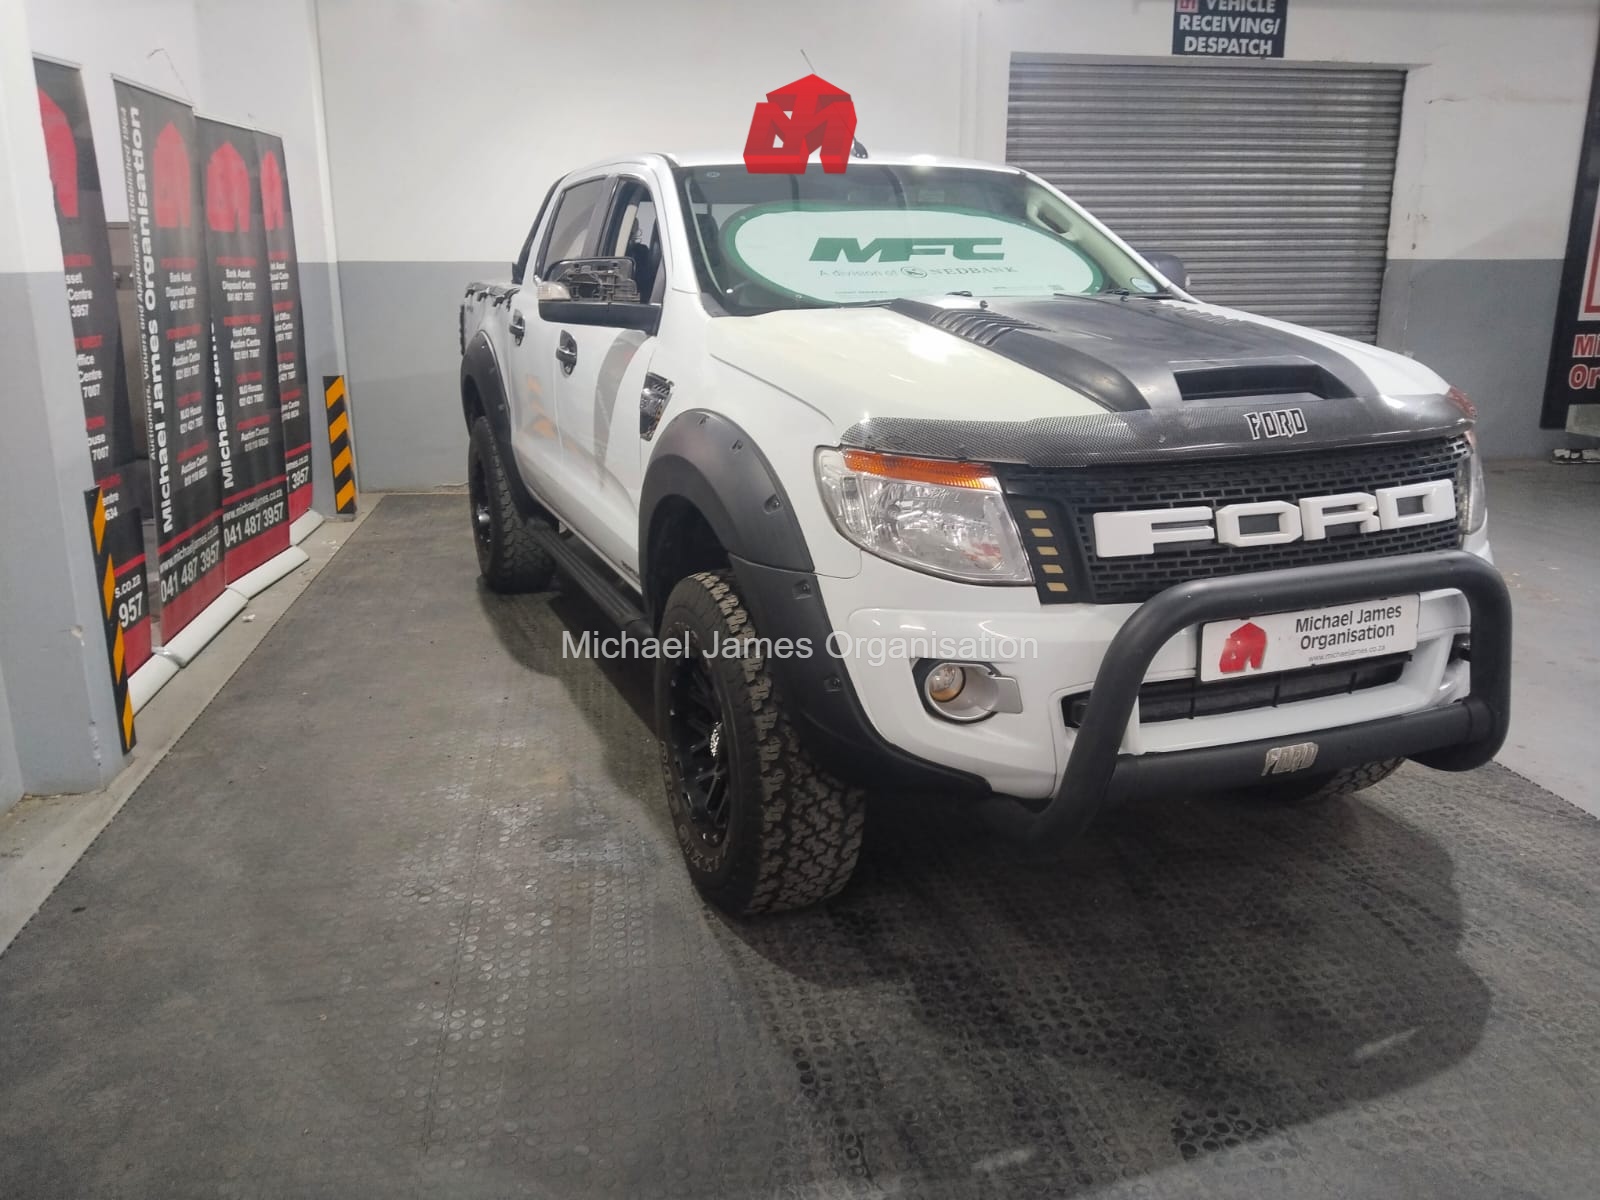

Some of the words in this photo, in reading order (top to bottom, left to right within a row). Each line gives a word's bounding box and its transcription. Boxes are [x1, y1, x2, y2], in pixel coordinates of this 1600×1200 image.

[1206, 0, 1276, 13] VEHICLE
[1179, 14, 1280, 35] RECEIVING/
[1184, 36, 1273, 55] DESPATCH
[130, 107, 156, 311] Organisation
[808, 237, 1005, 263] MFC
[70, 304, 89, 318] 3957
[77, 354, 95, 366] ffice
[148, 319, 164, 414] James
[1243, 407, 1308, 440] FORD
[88, 433, 106, 447] ouse
[215, 394, 234, 489] Michael
[157, 422, 173, 533] Michael
[102, 492, 119, 507] entre
[223, 488, 283, 522] www.michaeljames.co.za
[105, 507, 118, 521] 634
[223, 522, 243, 548] 041
[244, 511, 262, 537] 487
[263, 502, 284, 528] 3957
[1093, 478, 1457, 558] FORD
[160, 570, 179, 602] 041
[181, 557, 198, 585] 487
[200, 540, 220, 573] 3957
[115, 574, 141, 599] s.co.za
[119, 592, 143, 628] 957
[1295, 610, 1353, 633] Michael
[1356, 605, 1402, 625] James
[1300, 624, 1395, 650] Organisation
